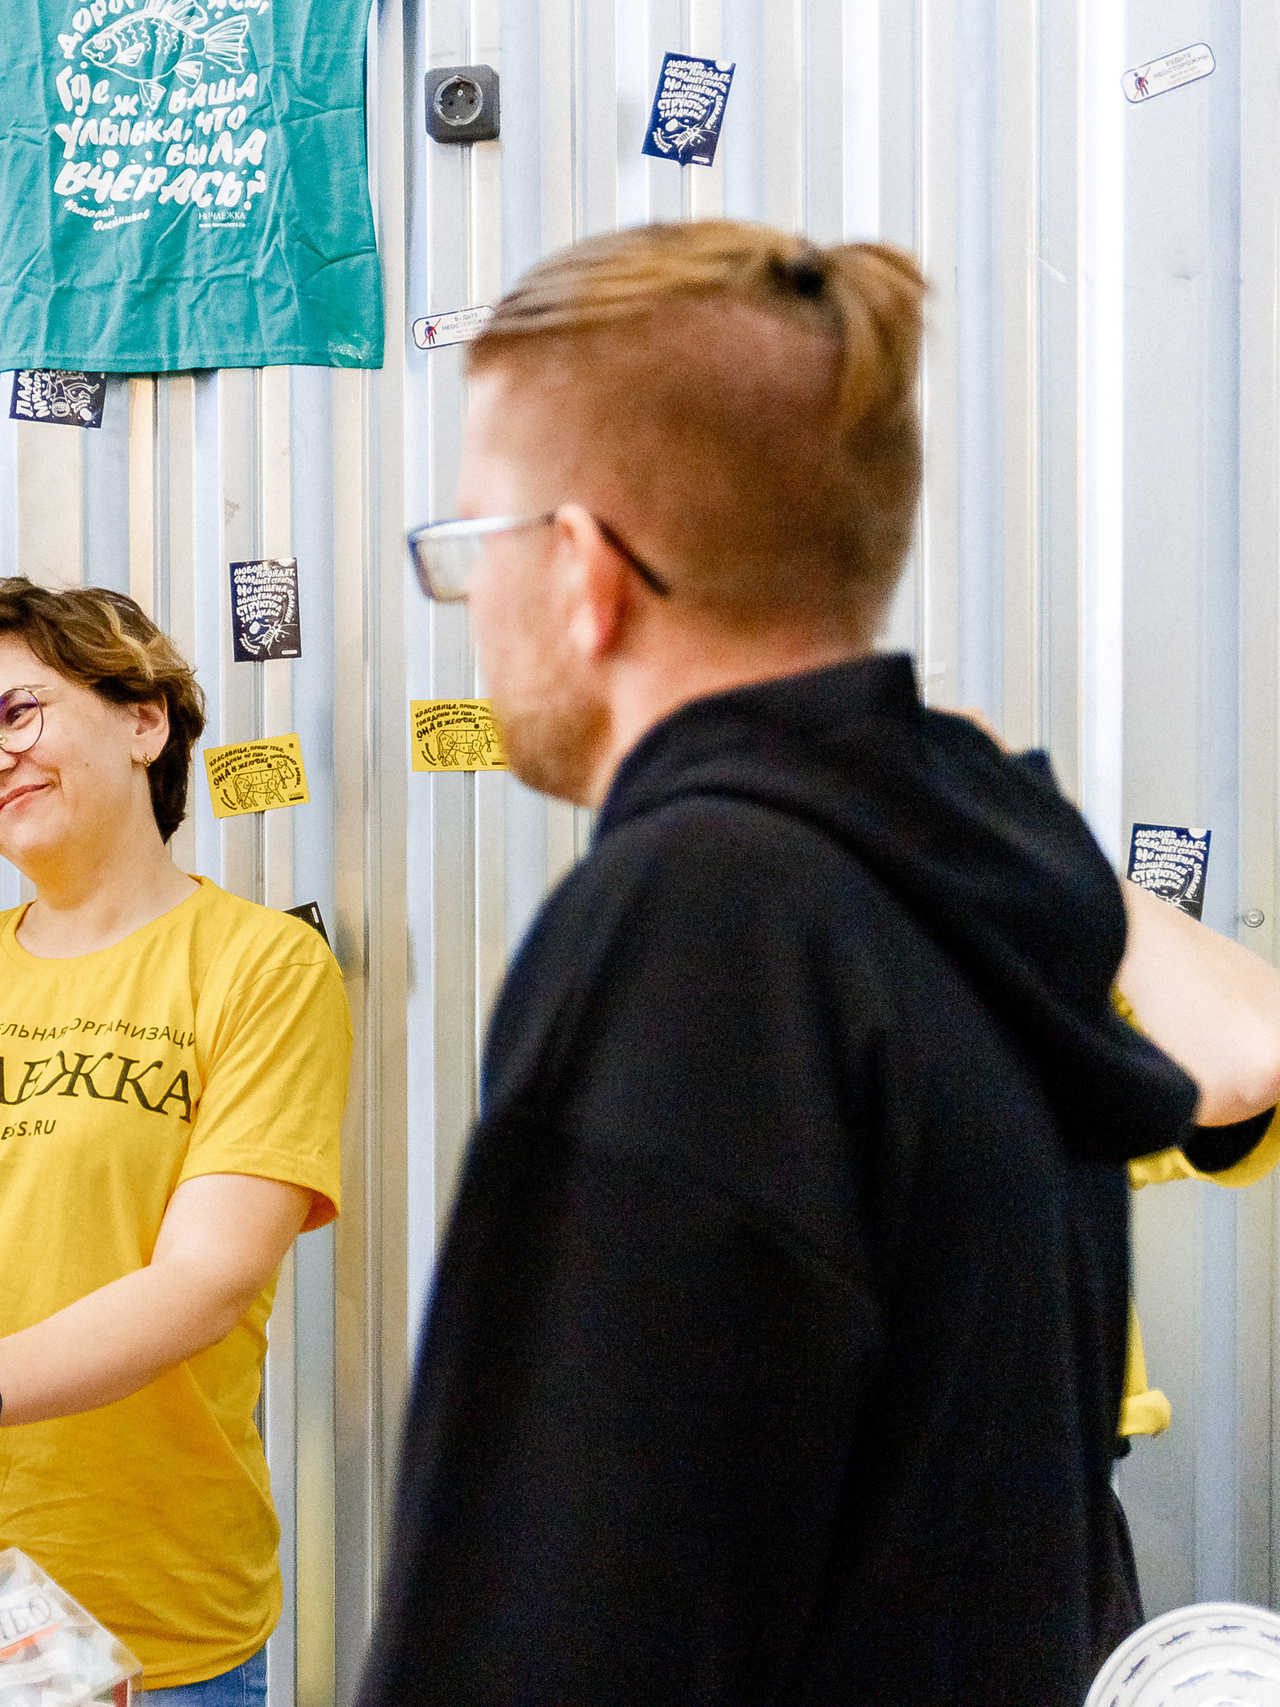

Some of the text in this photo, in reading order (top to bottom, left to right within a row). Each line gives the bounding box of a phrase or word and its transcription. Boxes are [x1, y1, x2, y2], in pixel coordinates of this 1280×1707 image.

[169, 73, 258, 114] ВАША
[664, 77, 681, 91] НО
[54, 105, 247, 160] УЛЫБКА, ЧТО
[166, 128, 267, 166] БЫЛА
[54, 161, 267, 211] ВЧЕРАСЬ?
[16, 369, 34, 417] ПЛАЧ
[234, 564, 267, 576] ЛЮБОВ
[236, 584, 252, 597] НО
[253, 584, 287, 594] ЛИШЕНА
[1135, 848, 1155, 862] НО
[1140, 879, 1181, 890] АРАКАНА
[69, 1017, 195, 1049] ОРГАНИЗАЦИ
